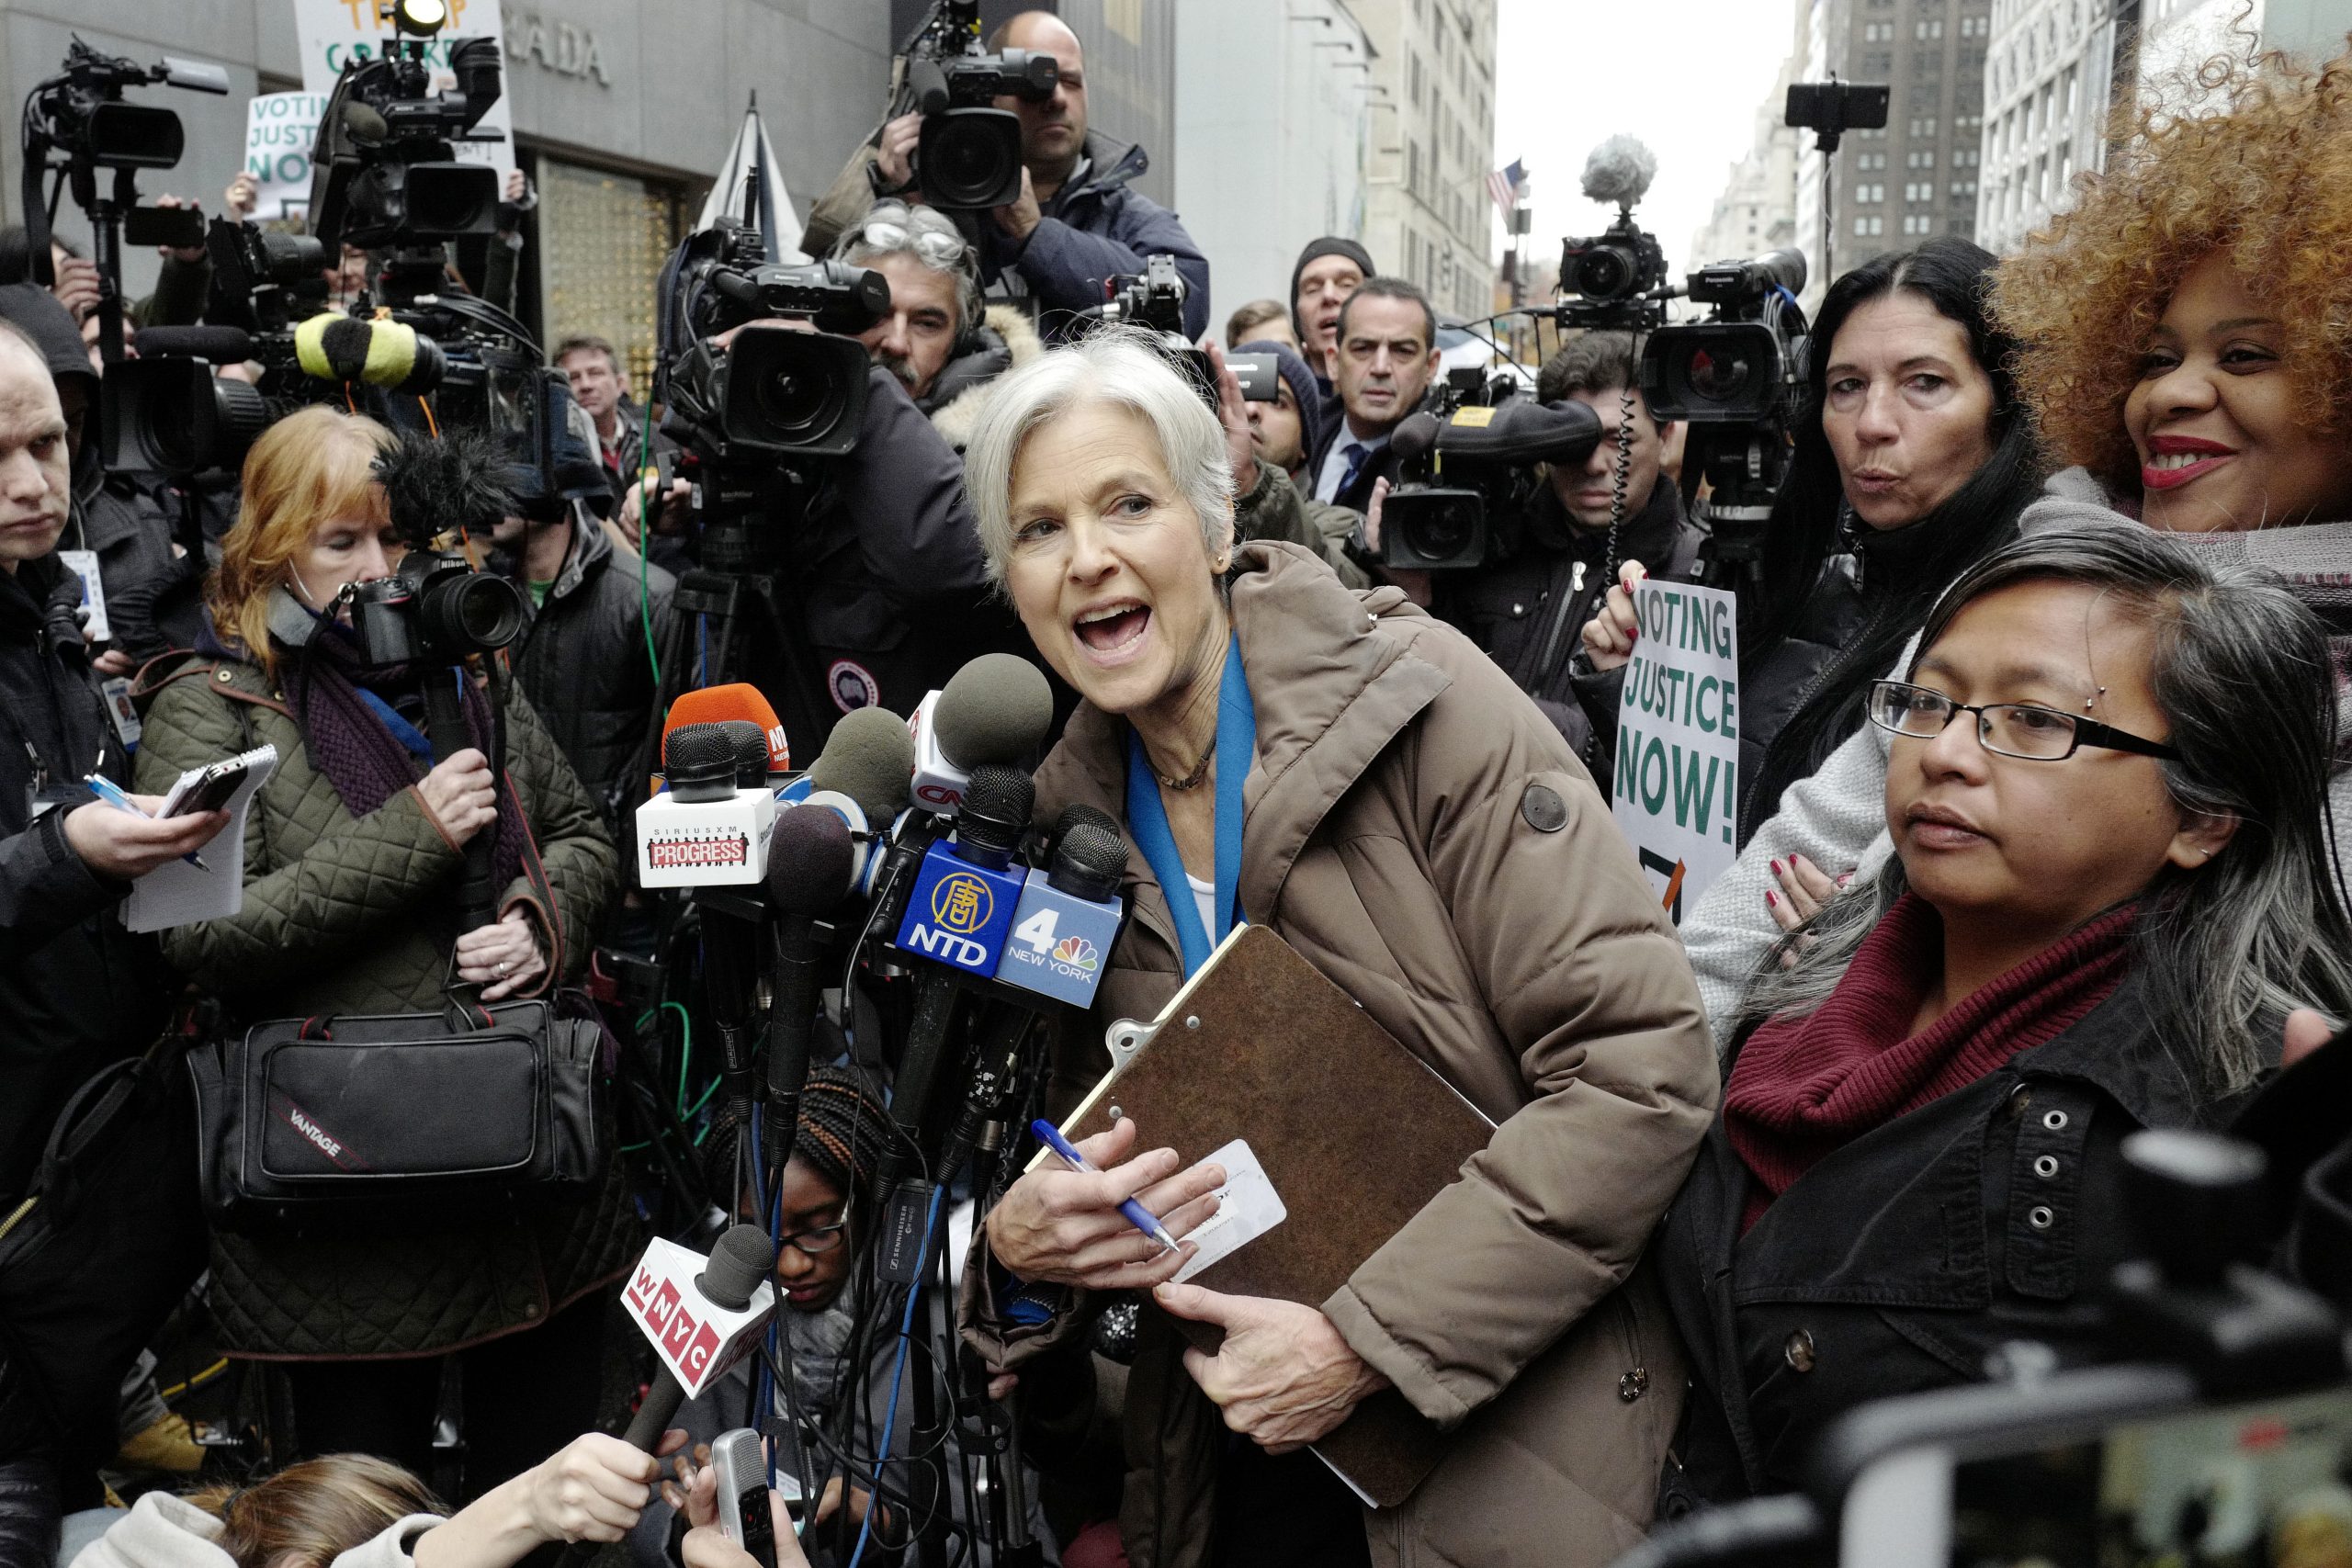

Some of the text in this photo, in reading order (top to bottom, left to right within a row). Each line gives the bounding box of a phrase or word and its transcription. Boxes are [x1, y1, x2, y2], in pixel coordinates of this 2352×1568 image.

[254, 96, 332, 119] VOTI
[249, 125, 318, 147] JUST
[248, 152, 309, 184] NO
[441, 559, 466, 569] Nikon
[1631, 588, 1732, 660] VOTING
[1624, 656, 1736, 740] JUSTICE
[916, 784, 963, 807] CN
[1616, 724, 1736, 846] NOW!
[653, 840, 743, 864] PROGRESS
[908, 922, 988, 967] NTD
[1014, 908, 1060, 955] 4
[1008, 946, 1094, 985] NEW YORK
[290, 1108, 342, 1157] VANTAGE
[893, 1205, 908, 1258] SENNHEISER
[636, 1265, 707, 1370] WNYC
